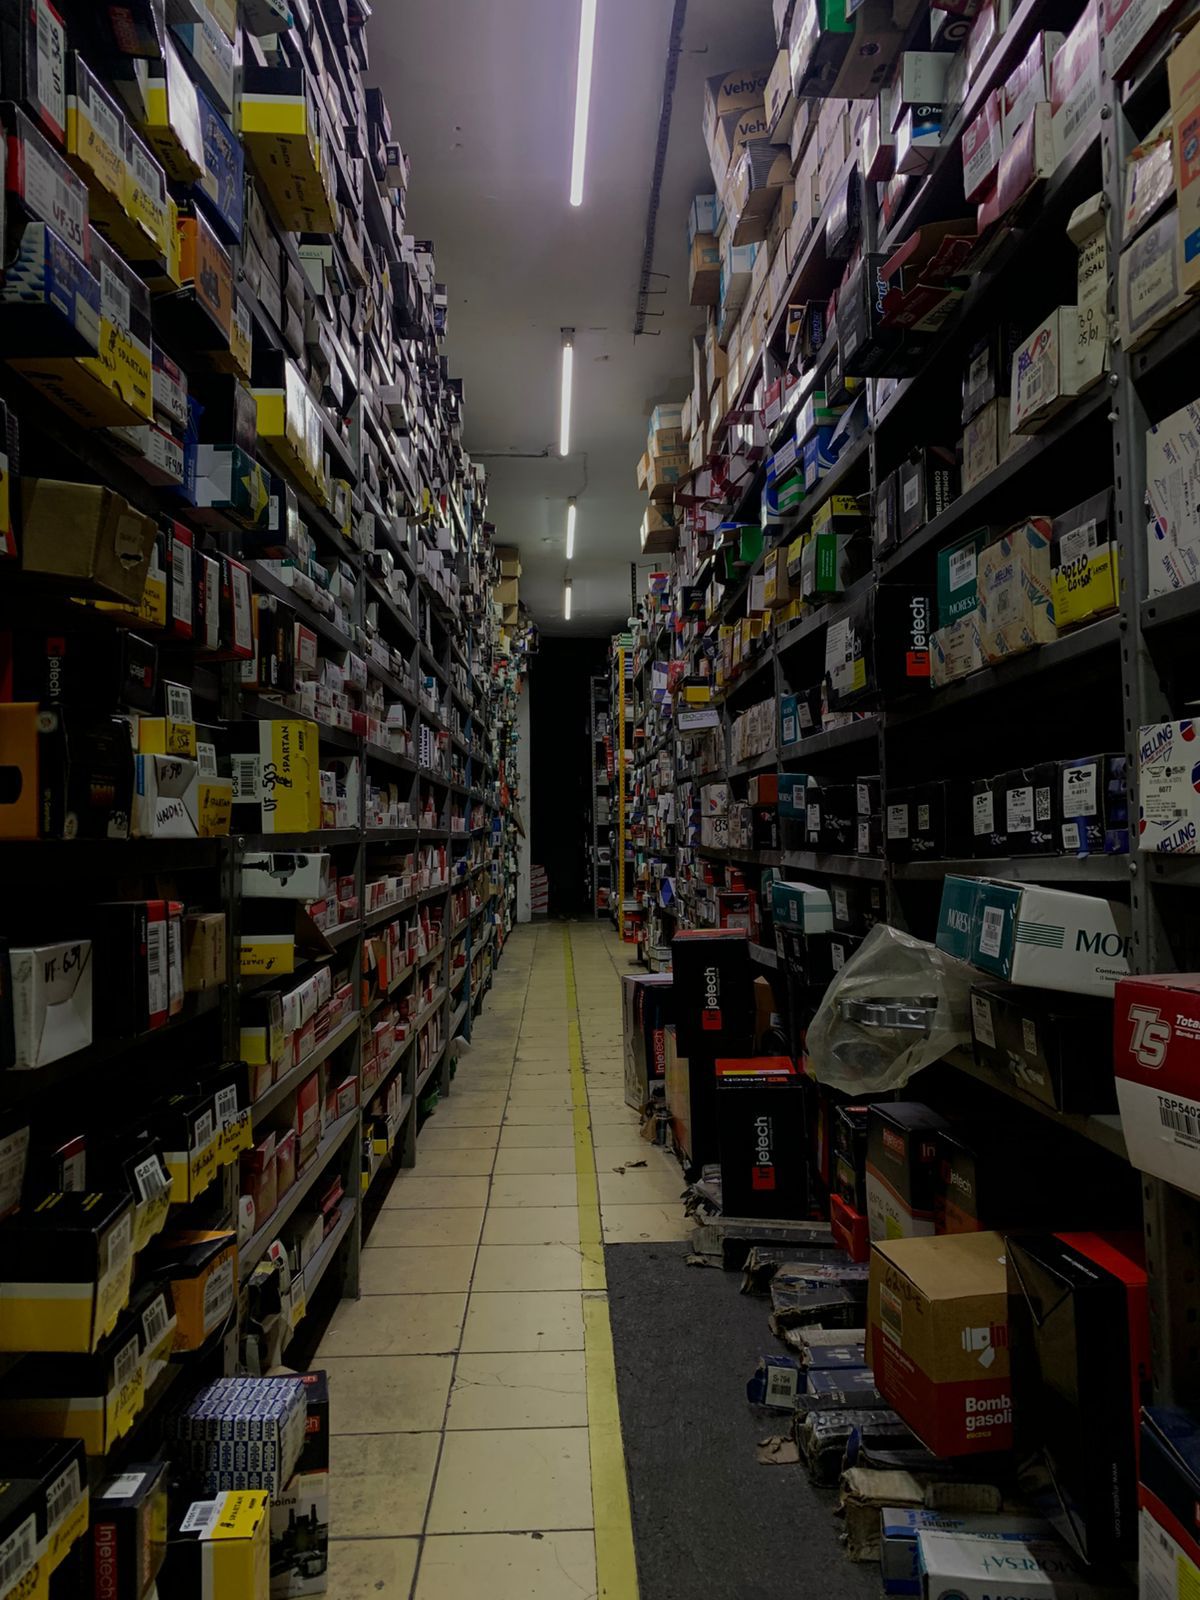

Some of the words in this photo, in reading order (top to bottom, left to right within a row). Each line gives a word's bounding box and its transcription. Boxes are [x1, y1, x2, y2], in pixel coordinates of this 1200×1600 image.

[118, 346, 149, 381] SPARTAN
[949, 596, 976, 616] MORESA
[280, 725, 290, 775] SPARTAN
[1128, 1003, 1172, 1070] TS
[230, 1495, 243, 1522] SPARTAN
[100, 1526, 117, 1600] Injetech
